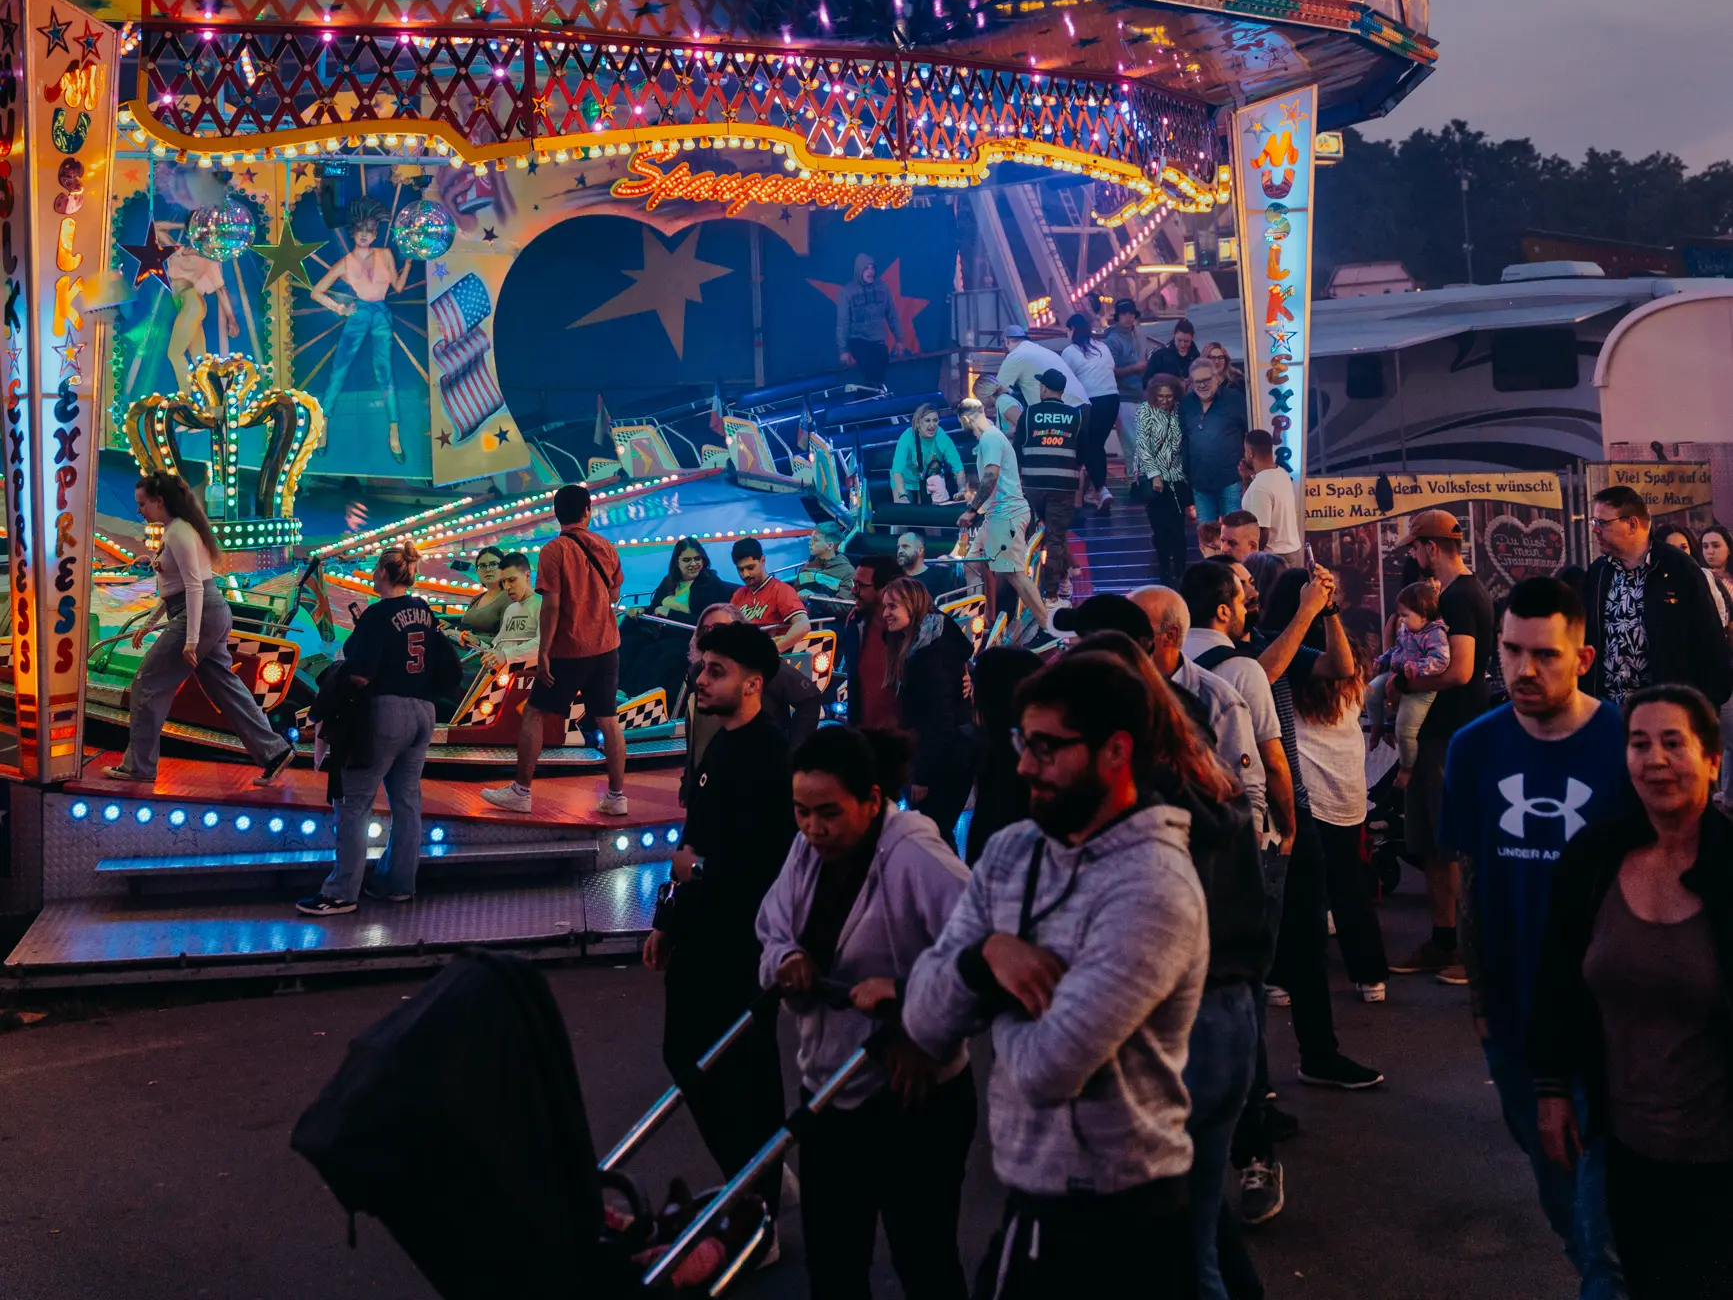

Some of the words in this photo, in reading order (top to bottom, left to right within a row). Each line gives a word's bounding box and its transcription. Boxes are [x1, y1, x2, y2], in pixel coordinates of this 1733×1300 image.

[1034, 413, 1074, 424] CREW
[1265, 353, 1295, 474] EXPR
[1041, 437, 1063, 445] 3000
[1615, 470, 1639, 484] Viel
[1644, 470, 1674, 486] Spaß
[1305, 484, 1321, 497] iel
[1326, 483, 1363, 498] Spaß
[1393, 482, 1423, 494] dem
[1427, 480, 1492, 493] Volksfest
[1495, 480, 1554, 493] wünscht
[1663, 492, 1694, 505] Marx
[1305, 505, 1345, 518] amilie
[1349, 504, 1387, 518] Marx
[1493, 533, 1519, 545] Du
[1521, 533, 1547, 547] bist
[1513, 547, 1543, 557] mein
[391, 608, 433, 631] FREEMAN
[505, 615, 529, 631] VANS
[406, 631, 426, 674] 5
[1497, 846, 1540, 859] UNDER
